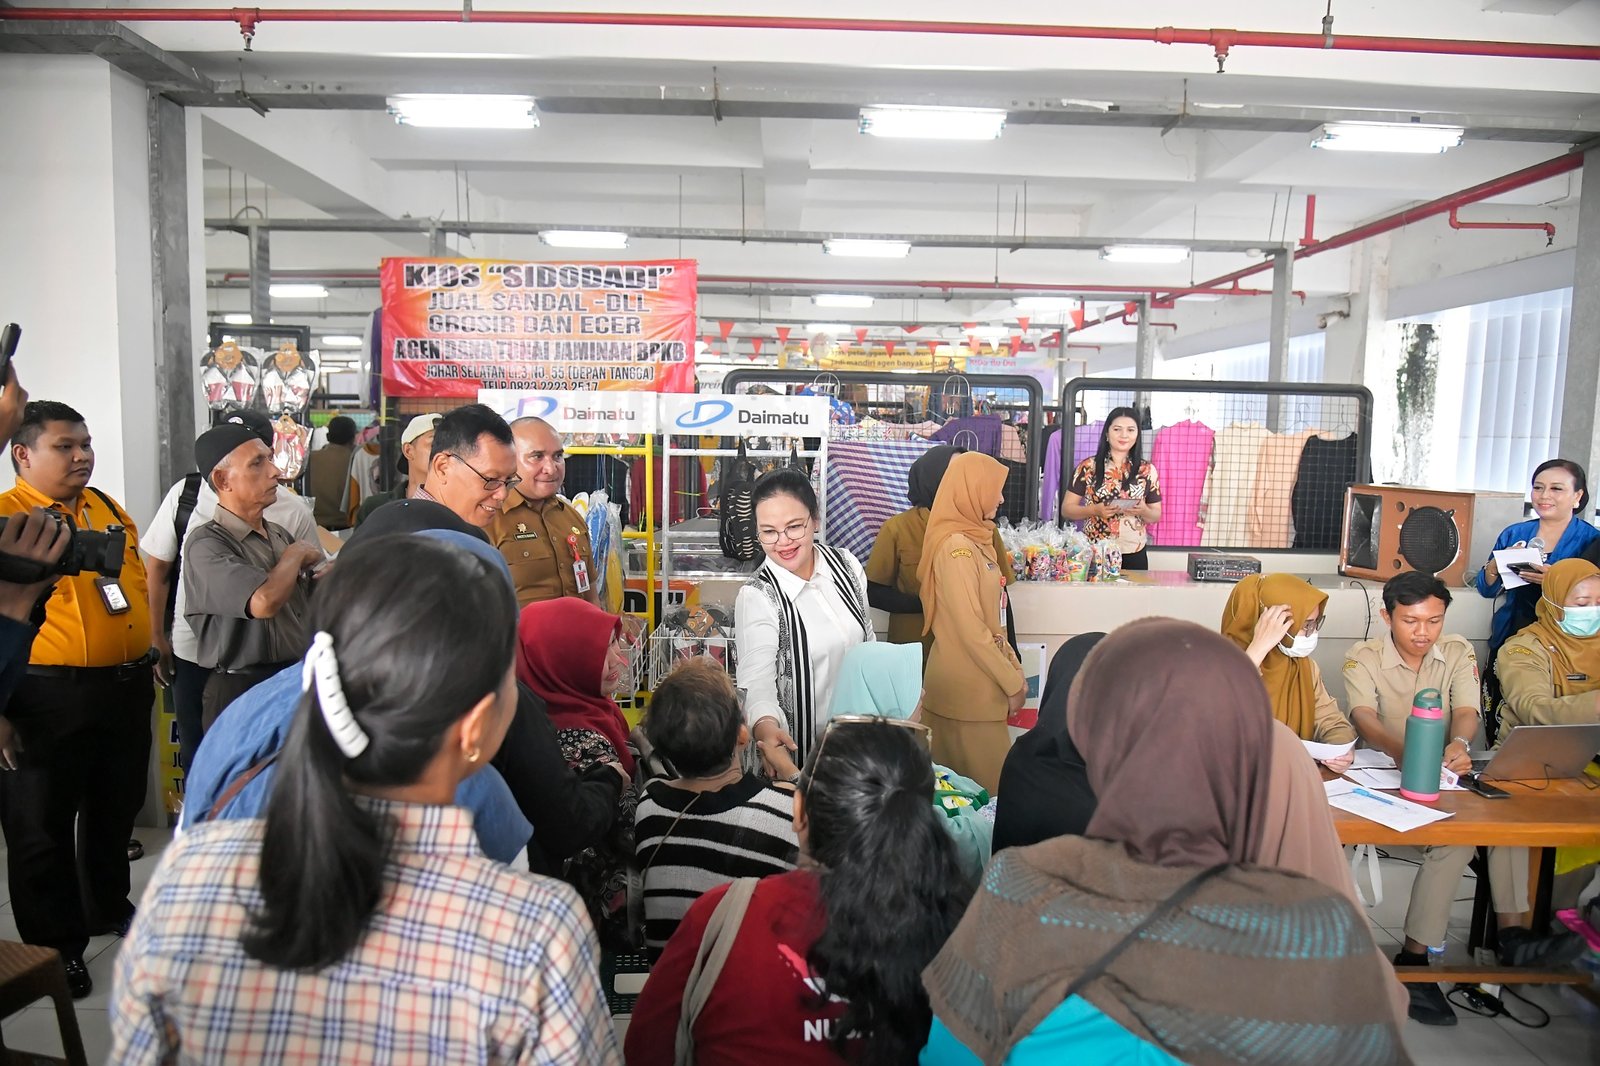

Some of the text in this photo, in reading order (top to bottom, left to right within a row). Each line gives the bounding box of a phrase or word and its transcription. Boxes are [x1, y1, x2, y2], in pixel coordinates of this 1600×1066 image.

[404, 264, 480, 288] KIOS
[428, 292, 484, 311] JUAL
[492, 292, 588, 312] SANDAL
[428, 315, 642, 334] GROSIR DAN ECER
[394, 339, 441, 360] AGEN
[553, 341, 632, 361] JAMINAN
[636, 341, 686, 362] BPKB
[426, 365, 459, 378] JOHAR
[461, 365, 505, 379] SELATAN
[551, 366, 565, 379] 55
[877, 360, 895, 368] agen
[896, 360, 923, 368] banyak
[562, 406, 636, 421] Daimatu
[737, 409, 810, 425] Daimatu
